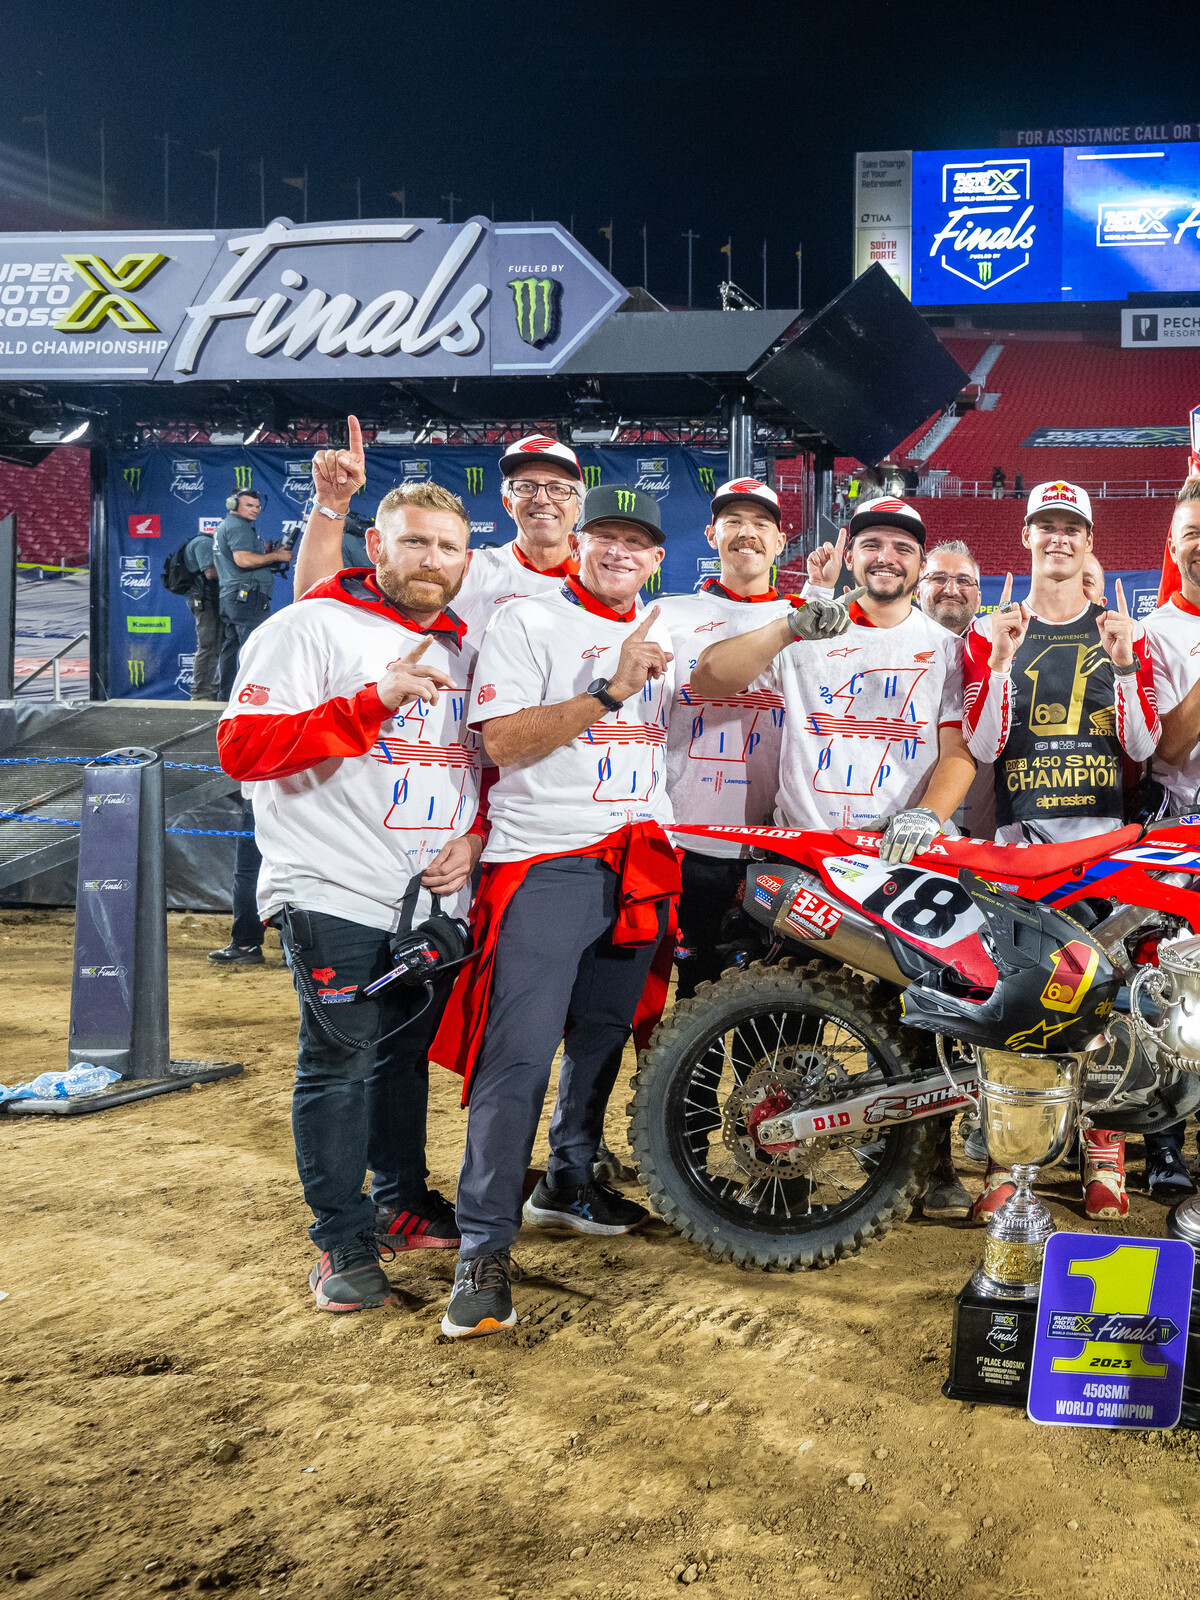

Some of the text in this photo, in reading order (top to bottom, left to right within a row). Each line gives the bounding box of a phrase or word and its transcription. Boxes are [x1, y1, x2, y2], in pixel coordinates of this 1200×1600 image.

[1017, 131, 1043, 145] FOR
[1047, 127, 1130, 144] ASSISTANCE
[1134, 125, 1168, 141] CALL
[1173, 124, 1191, 139] OR
[871, 214, 891, 222] TIAA
[930, 205, 1036, 257] Finals
[870, 241, 897, 250] SOUTH
[0, 263, 76, 282] PER
[508, 264, 565, 273] FUELED BY
[0, 285, 70, 305] OTO
[174, 221, 492, 375] Finals
[0, 307, 70, 327] OSS
[1163, 330, 1200, 338] RESORT
[32, 341, 168, 354] CHAMPIONSHIP
[170, 475, 204, 492] Finals
[282, 476, 313, 492] Final
[634, 474, 671, 490] Finals
[1042, 492, 1077, 504] Red Bull
[120, 572, 151, 587] Finals
[175, 668, 194, 685] Fin
[1089, 728, 1115, 736] HON
[1007, 755, 1118, 770] 2023 450 SMX
[1036, 794, 1096, 809] alpinestars
[707, 826, 801, 839] DUNLOP
[855, 835, 949, 856] HOA
[792, 890, 842, 930] ヨシムラ
[862, 867, 974, 938] 18
[788, 911, 826, 939] YOSHIMURA
[813, 1112, 850, 1131] D.I.D
[986, 1326, 1018, 1341] Finals
[1095, 1313, 1157, 1341] Finals
[984, 1357, 1001, 1367] PLACE
[1002, 1360, 1025, 1370] 450SMX
[1089, 1358, 1133, 1368] 2023
[1083, 1383, 1130, 1400] 450SMX
[1055, 1400, 1154, 1419] WORLD CHAMPION
